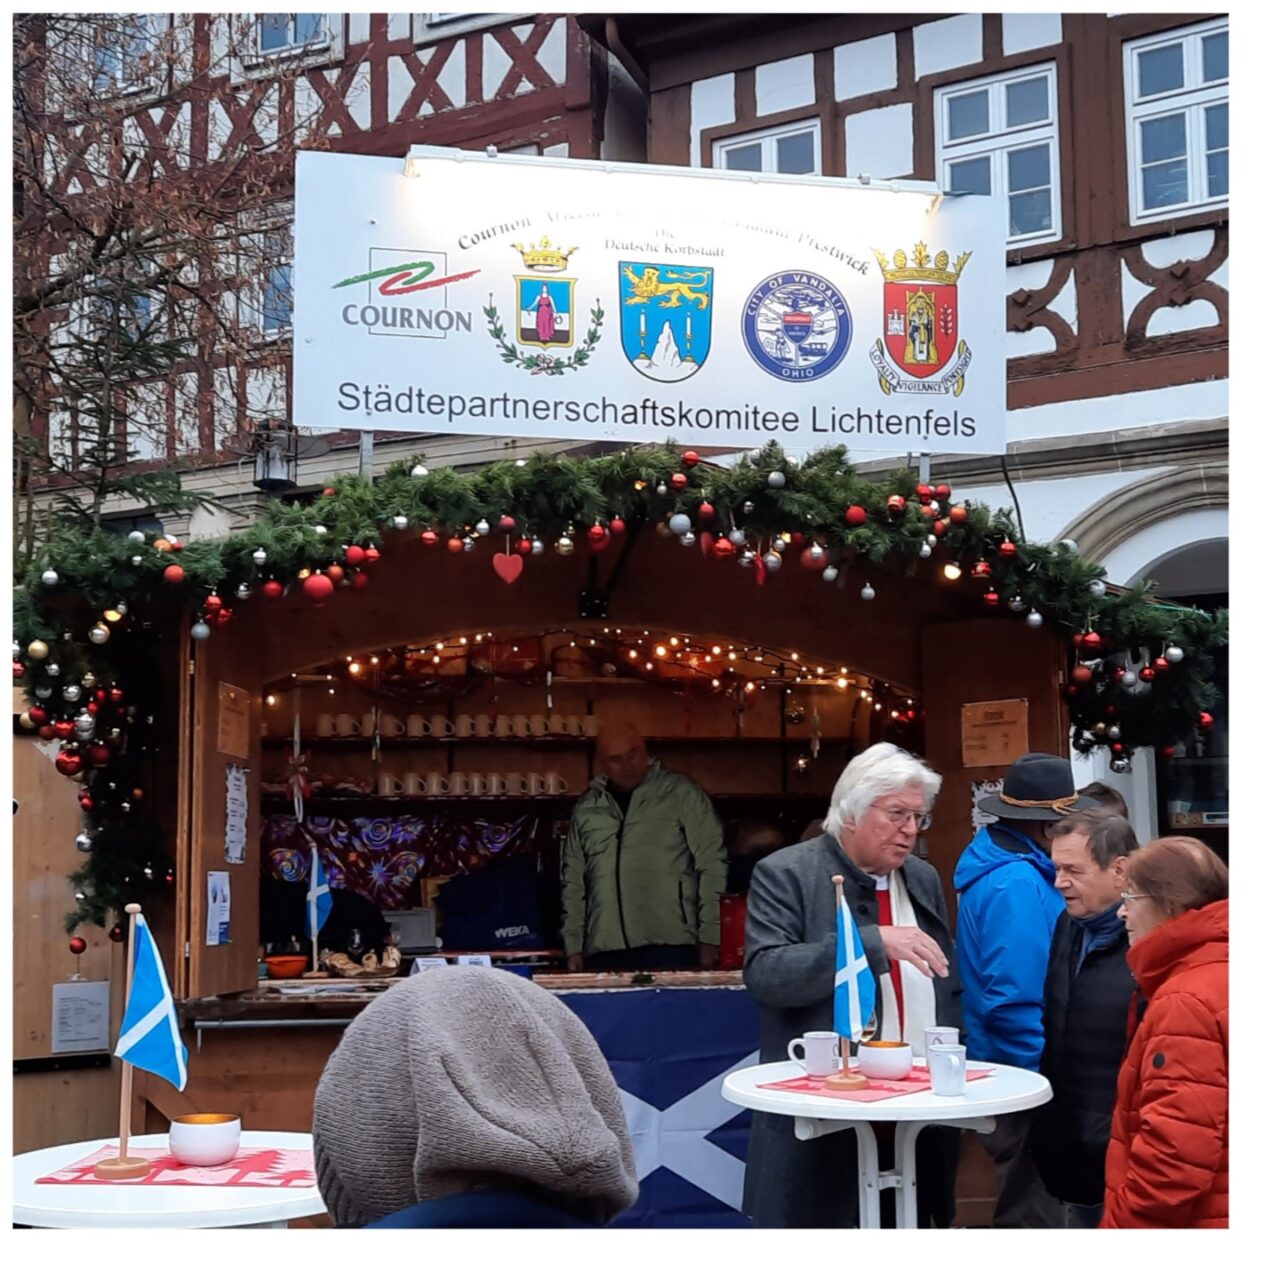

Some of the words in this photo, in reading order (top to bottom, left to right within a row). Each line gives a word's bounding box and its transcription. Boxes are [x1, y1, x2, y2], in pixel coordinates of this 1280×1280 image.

[458, 216, 531, 250] Cournon
[747, 291, 765, 316] CITY
[768, 276, 784, 289] OF
[793, 274, 846, 317] VANDALIA
[342, 304, 472, 333] COURNON
[782, 368, 815, 379] OHIO
[897, 381, 942, 393] VIGILANCE
[337, 381, 800, 433] Städtepartnerschaftskomitee
[811, 405, 977, 438] Lichtenfels
